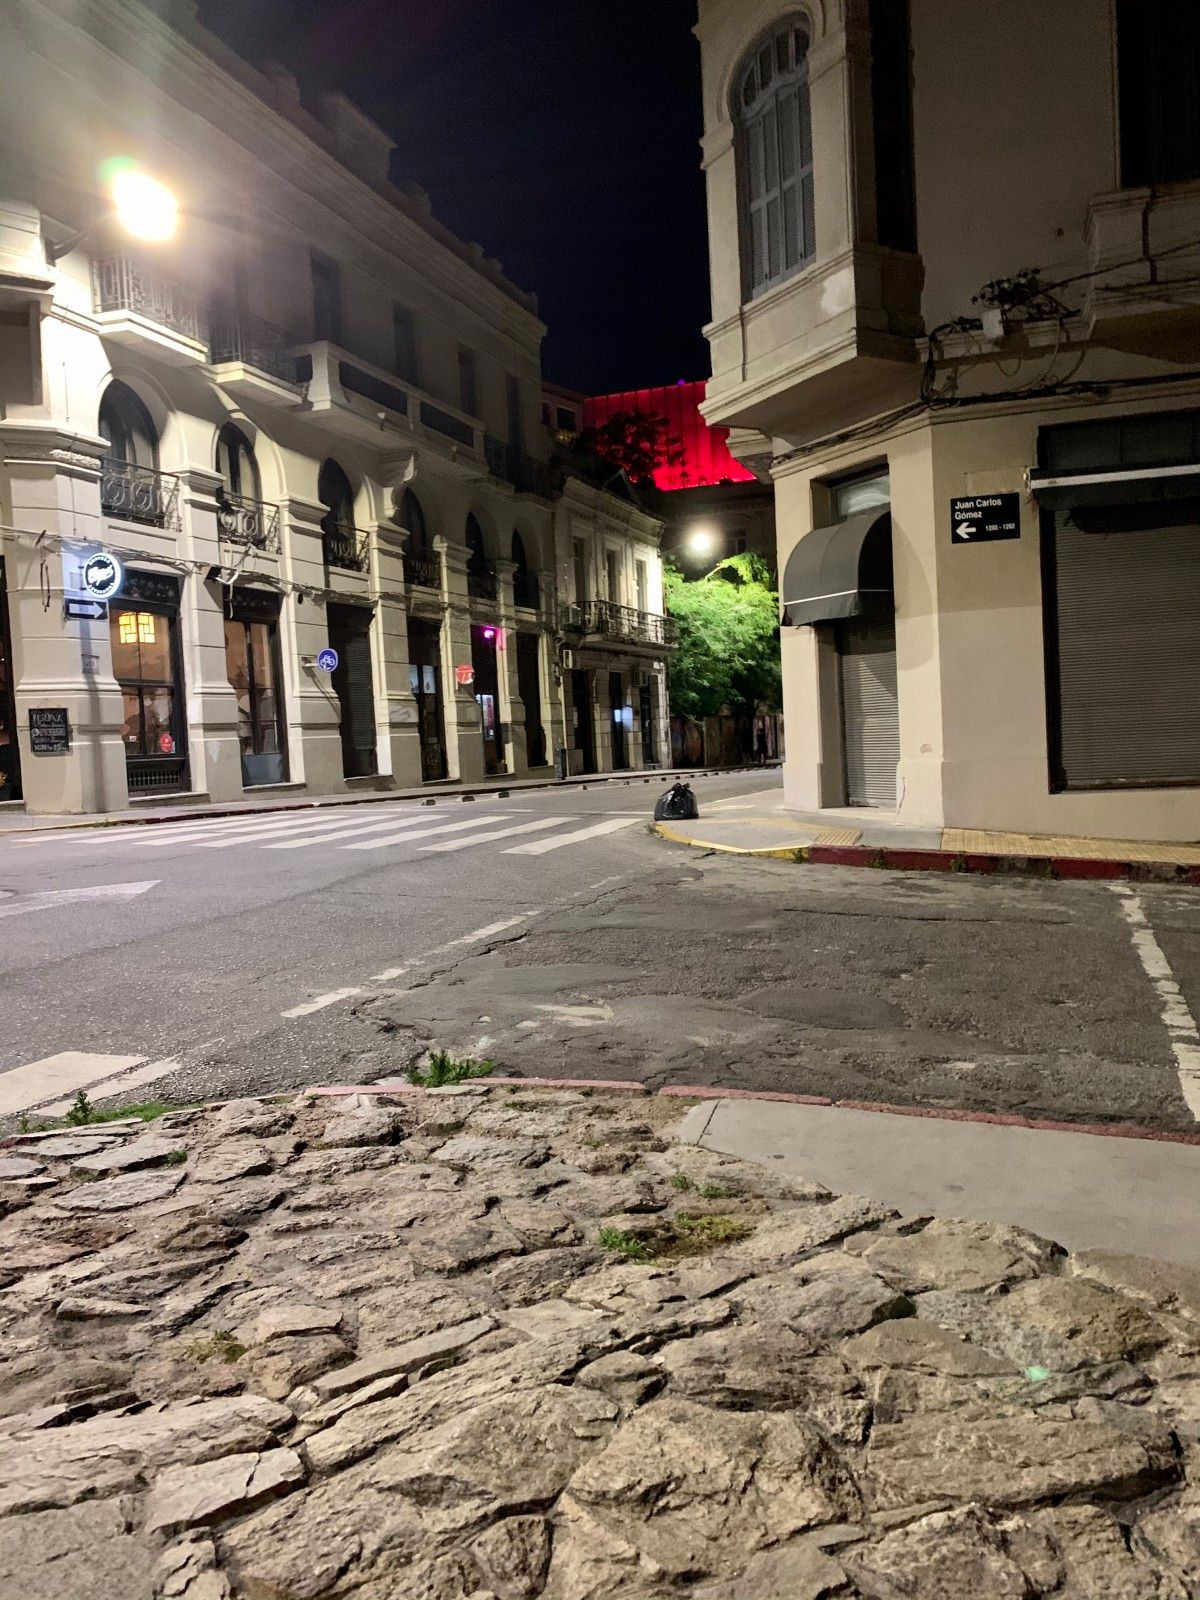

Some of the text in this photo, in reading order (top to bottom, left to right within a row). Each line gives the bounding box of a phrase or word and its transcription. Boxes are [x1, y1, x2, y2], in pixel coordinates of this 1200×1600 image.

[954, 498, 1002, 509] Juan Carlos
[954, 511, 982, 520] Gómez
